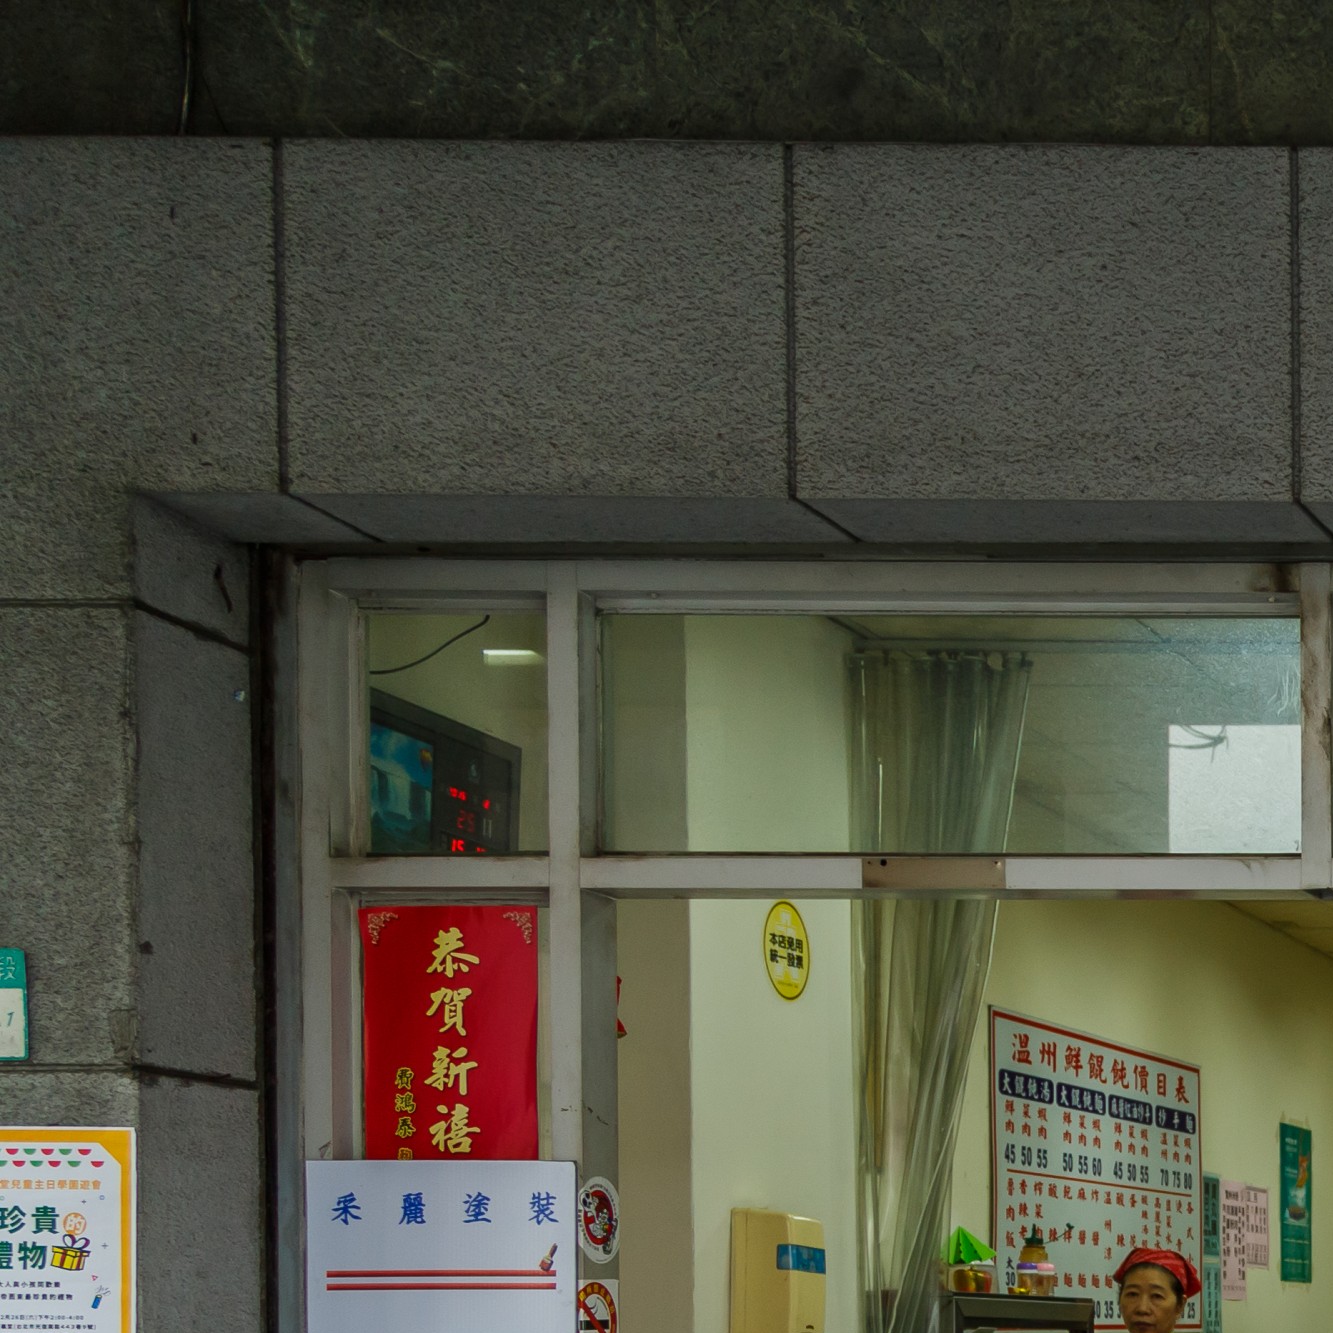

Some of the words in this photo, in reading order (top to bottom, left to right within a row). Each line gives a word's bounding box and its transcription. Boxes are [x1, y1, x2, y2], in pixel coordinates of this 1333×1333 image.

[424, 927, 480, 1154] 恭賀新禧
[1004, 1143, 1016, 1164] 45
[1021, 1145, 1032, 1166] 50
[1037, 1148, 1048, 1169] 55
[1062, 1152, 1073, 1172] 50
[1078, 1155, 1088, 1175] 55
[1092, 1157, 1102, 1176] 60
[1113, 1161, 1123, 1180] 45
[1127, 1163, 1136, 1182] 50
[1140, 1165, 1149, 1184] 55
[1160, 1168, 1169, 1186] 70
[1172, 1170, 1181, 1188] 75
[1184, 1172, 1192, 1190] 80
[330, 1191, 559, 1226] 采麗塗裝
[1006, 1272, 1016, 1286] 30
[1104, 1300, 1114, 1319] 35
